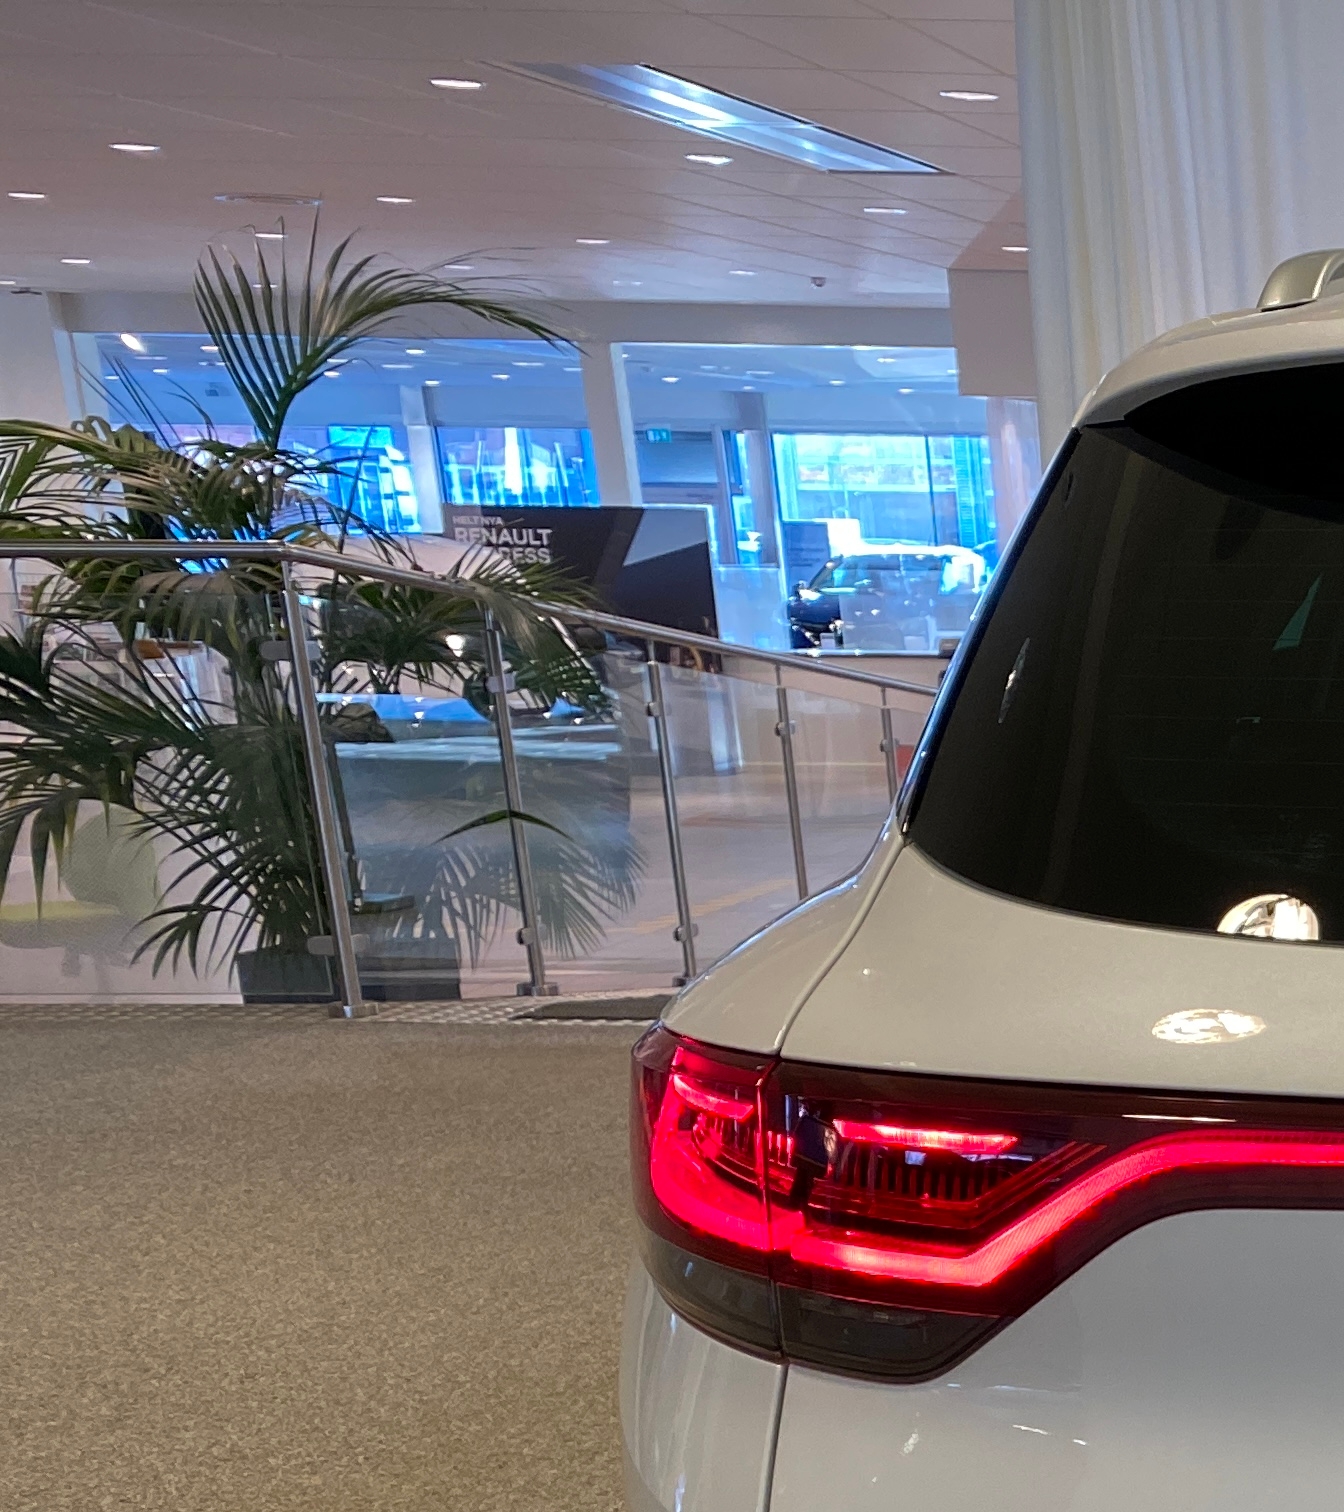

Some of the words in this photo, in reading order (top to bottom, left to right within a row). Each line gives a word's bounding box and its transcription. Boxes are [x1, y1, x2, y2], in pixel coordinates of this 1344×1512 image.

[452, 516, 480, 525] HELT
[481, 516, 503, 525] NYA
[454, 527, 553, 547] RENAULT
